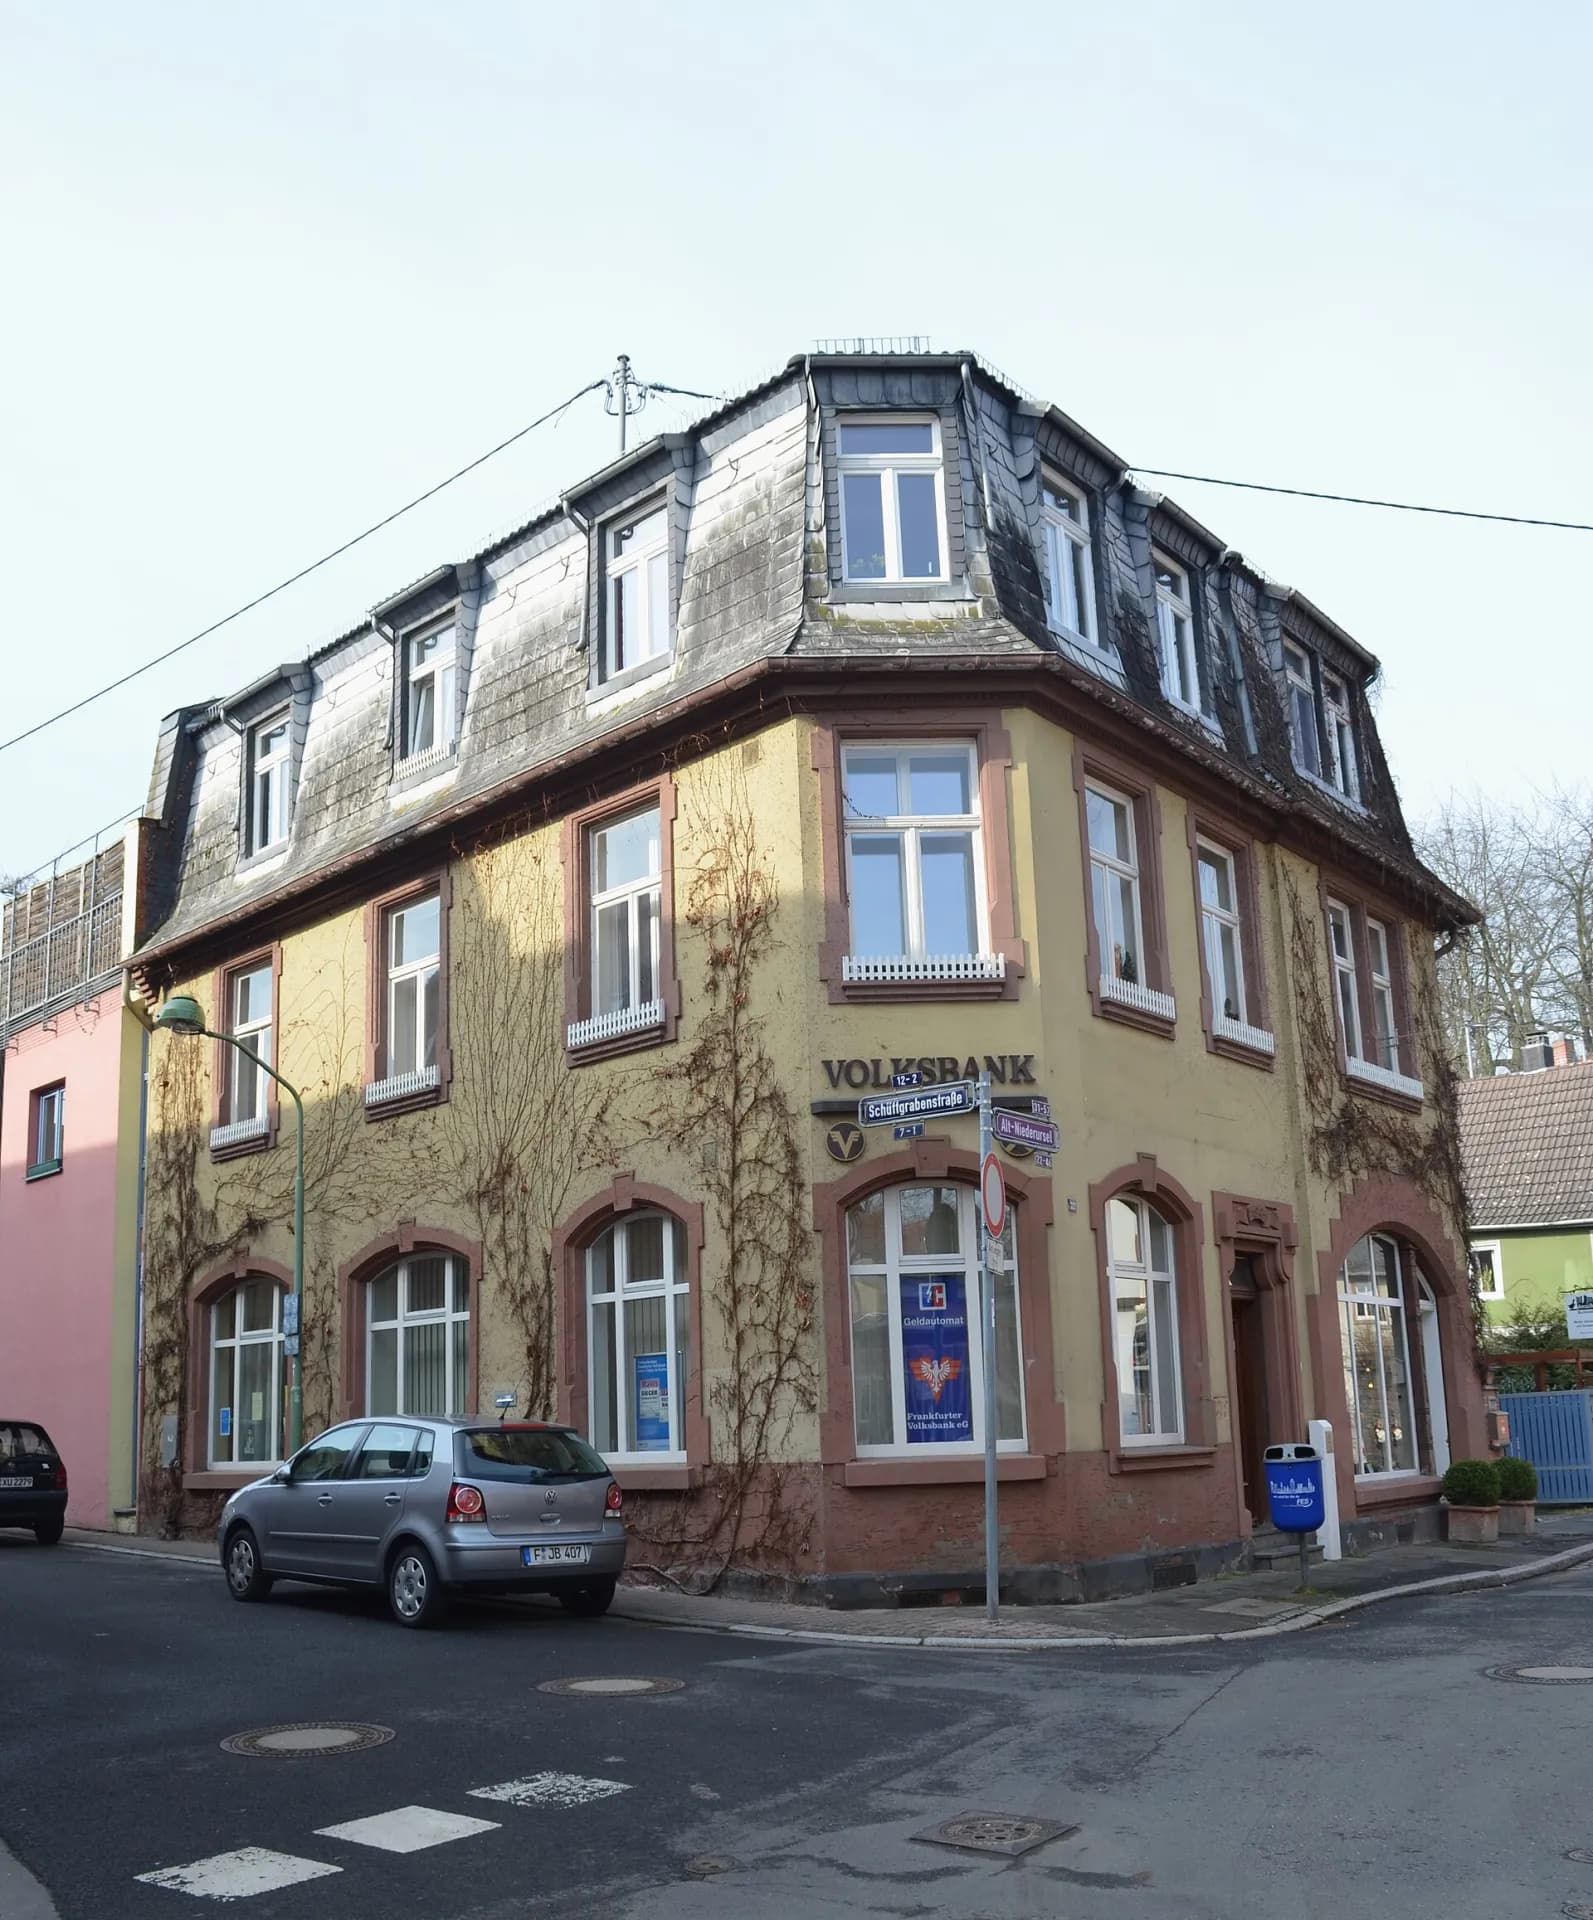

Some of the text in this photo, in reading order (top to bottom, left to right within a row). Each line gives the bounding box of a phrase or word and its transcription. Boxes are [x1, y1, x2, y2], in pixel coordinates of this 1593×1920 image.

[821, 1055, 1036, 1088] VOLKSBANK
[868, 1091, 963, 1118] Schüttgrabenstraße
[1001, 1117, 1053, 1144] Alt-Niederursel
[903, 1316, 964, 1327] Geldautomat
[907, 1412, 963, 1421] Frankfurter
[907, 1420, 969, 1430] Volksbank eG
[534, 1546, 582, 1560] F JB 407
